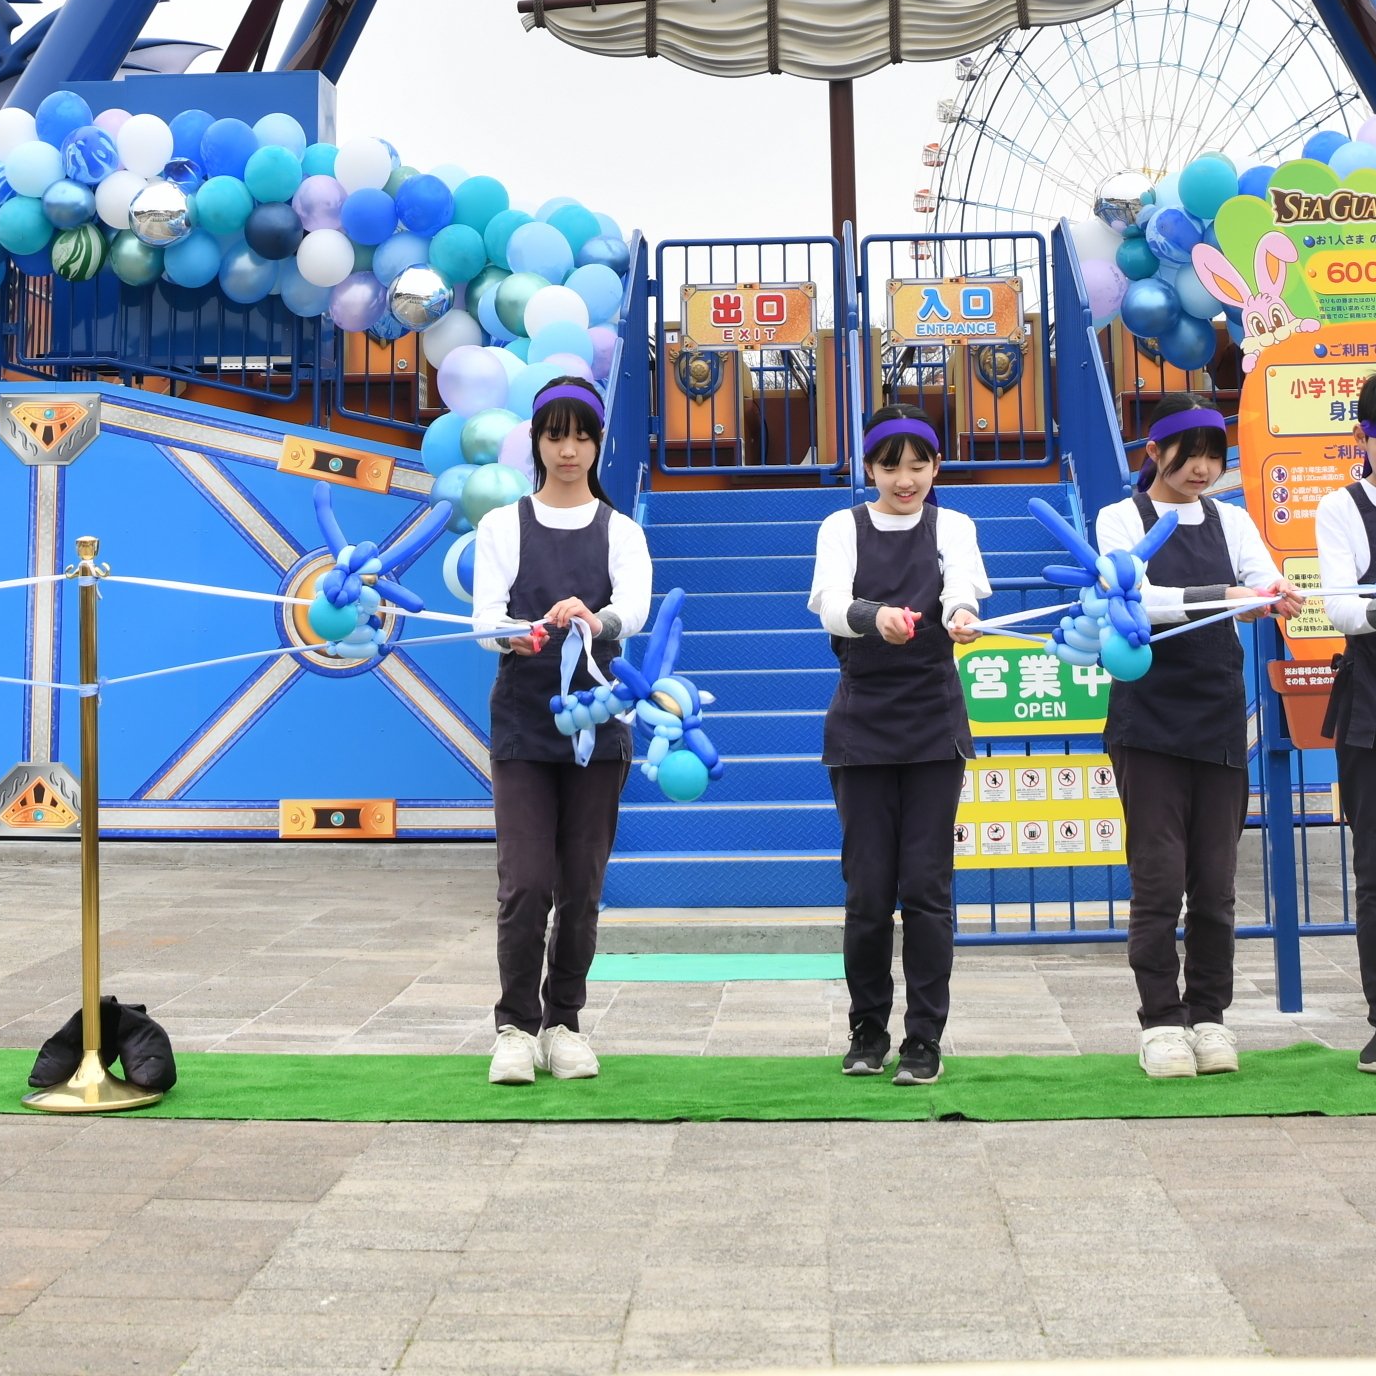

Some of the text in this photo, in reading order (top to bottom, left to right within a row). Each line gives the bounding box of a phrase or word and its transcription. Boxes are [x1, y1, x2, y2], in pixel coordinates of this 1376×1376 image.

[1280, 191, 1326, 222] SEA
[1316, 234, 1365, 246] お1人さま
[711, 292, 788, 328] 出口
[917, 286, 995, 322] 入口
[722, 327, 777, 343] EXIT
[915, 321, 997, 337] ENTRANCE
[966, 654, 1113, 700] 営業中
[1013, 701, 1067, 719] OPEN
